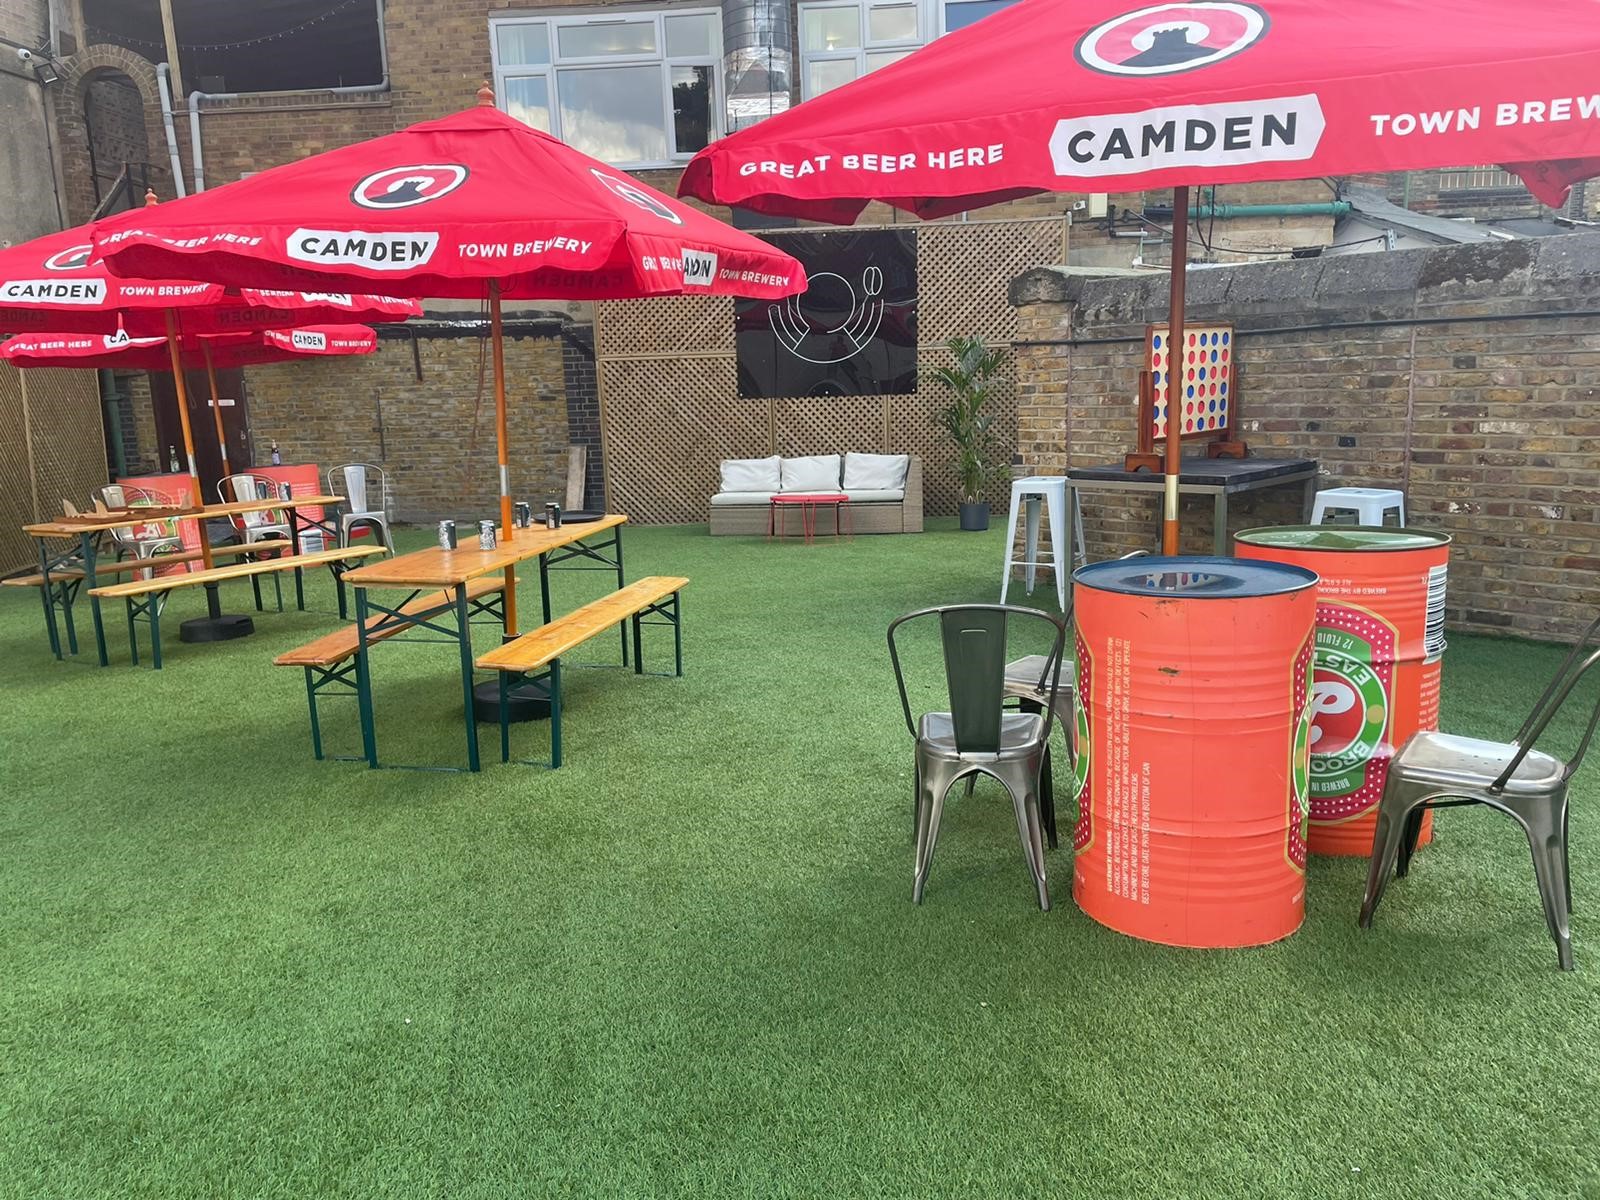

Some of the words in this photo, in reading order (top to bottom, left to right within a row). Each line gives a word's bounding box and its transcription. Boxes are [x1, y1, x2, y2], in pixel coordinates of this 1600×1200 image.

[1370, 107, 1481, 136] TOWN
[1068, 112, 1297, 163] CAMDEN
[740, 155, 831, 179] GREAT
[842, 153, 917, 173] BEER
[928, 144, 1004, 170] HERE
[99, 229, 158, 246] REA
[212, 233, 263, 246] HERE
[300, 238, 429, 263] CAMDEN
[458, 244, 507, 258] TOWN
[513, 237, 592, 257] BREWERY
[719, 268, 740, 280] TOWN
[741, 270, 789, 287] BREWERY
[8, 285, 98, 298] CAMDEN
[119, 286, 154, 296] TOWN
[158, 283, 210, 296] BREWERY
[40, 341, 65, 349] BEER
[68, 340, 92, 348] HERE
[1317, 632, 1341, 646] FLUID
[1342, 639, 1354, 650] 12
[1311, 782, 1320, 791] IN
[1321, 777, 1351, 792] BREWED
